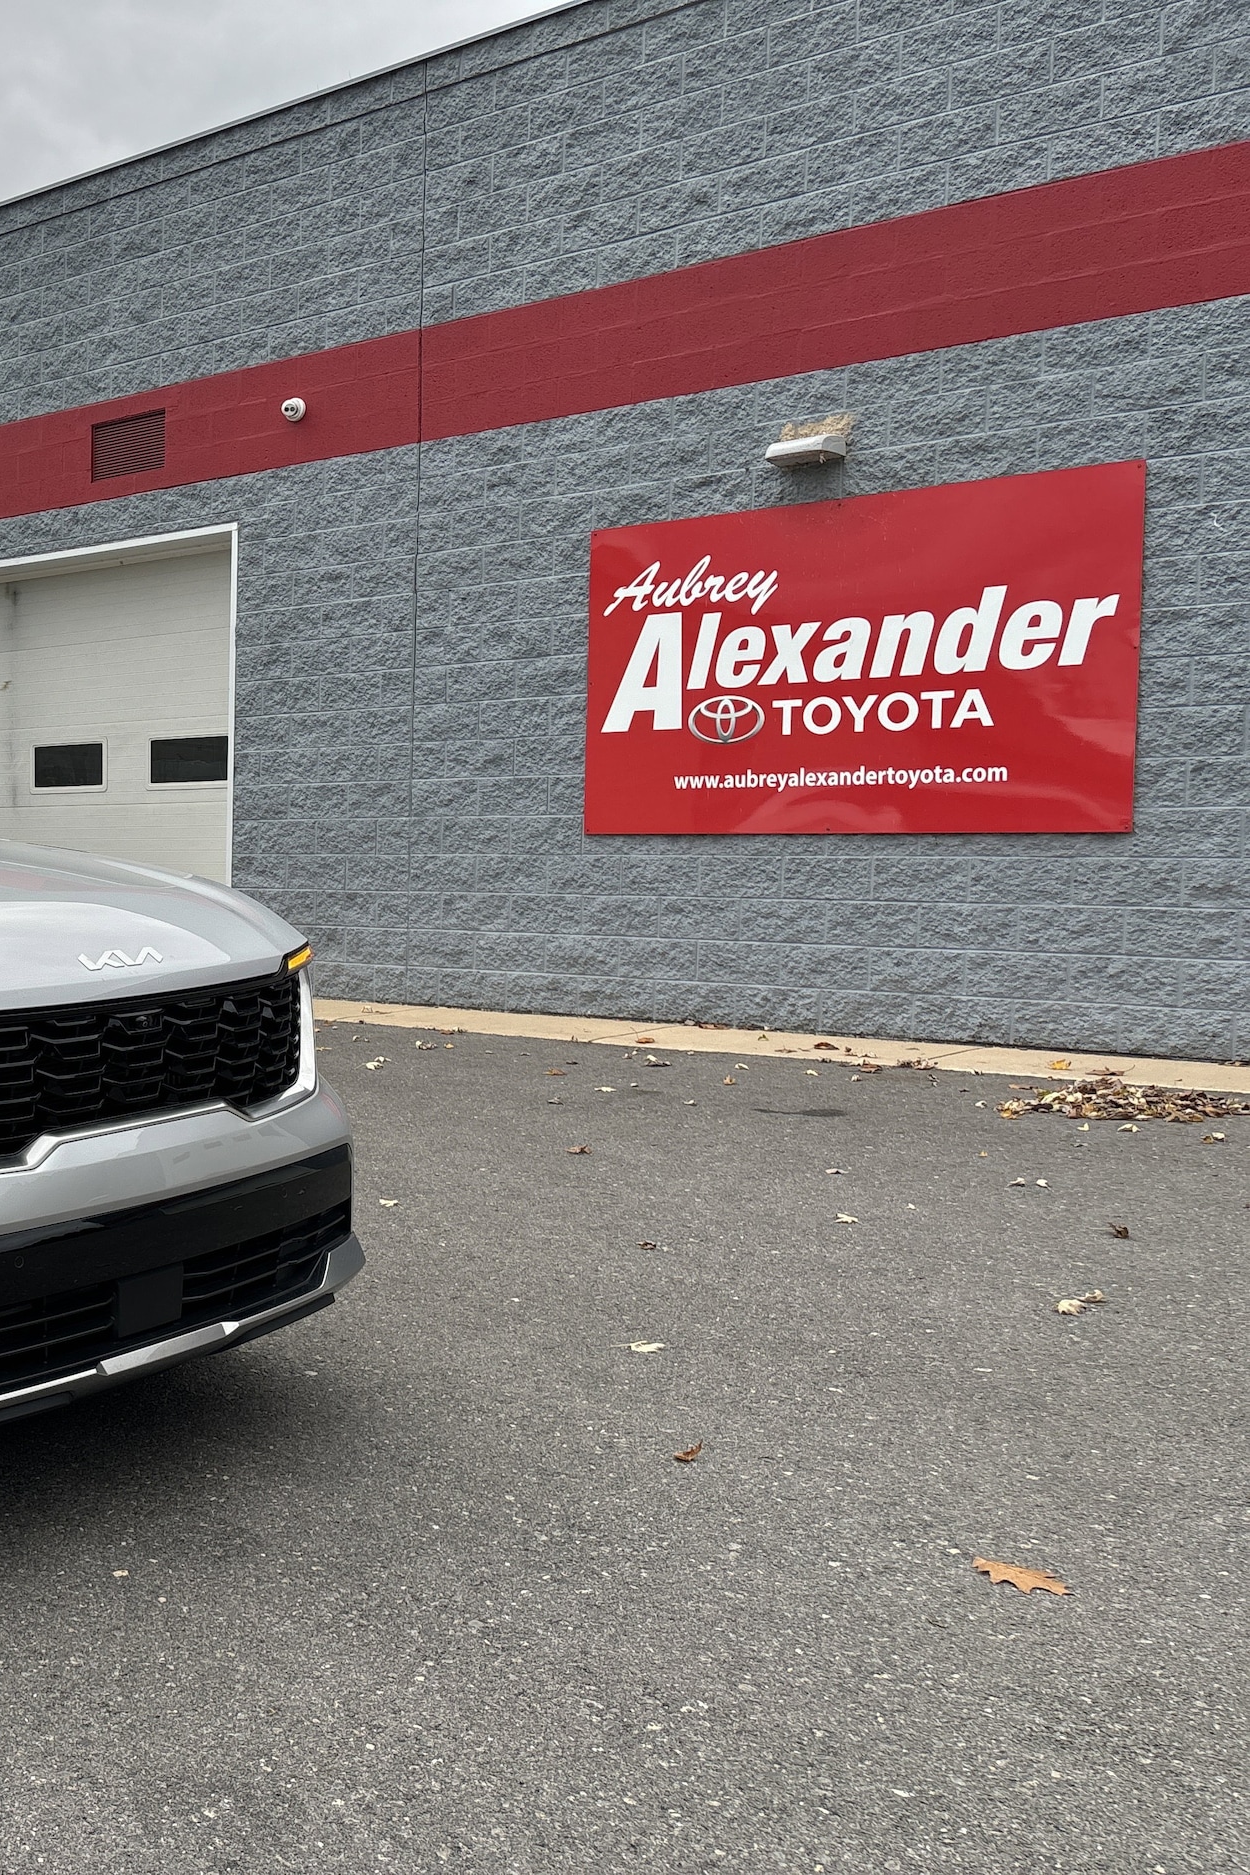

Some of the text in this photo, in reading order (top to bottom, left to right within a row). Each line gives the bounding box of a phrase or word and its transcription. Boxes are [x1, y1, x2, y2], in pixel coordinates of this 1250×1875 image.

[603, 555, 779, 617] Aubrey
[601, 585, 1120, 733] Alexander
[772, 688, 995, 736] TOYOTA
[673, 765, 1009, 793] www.aubreyalexandertoyota.com
